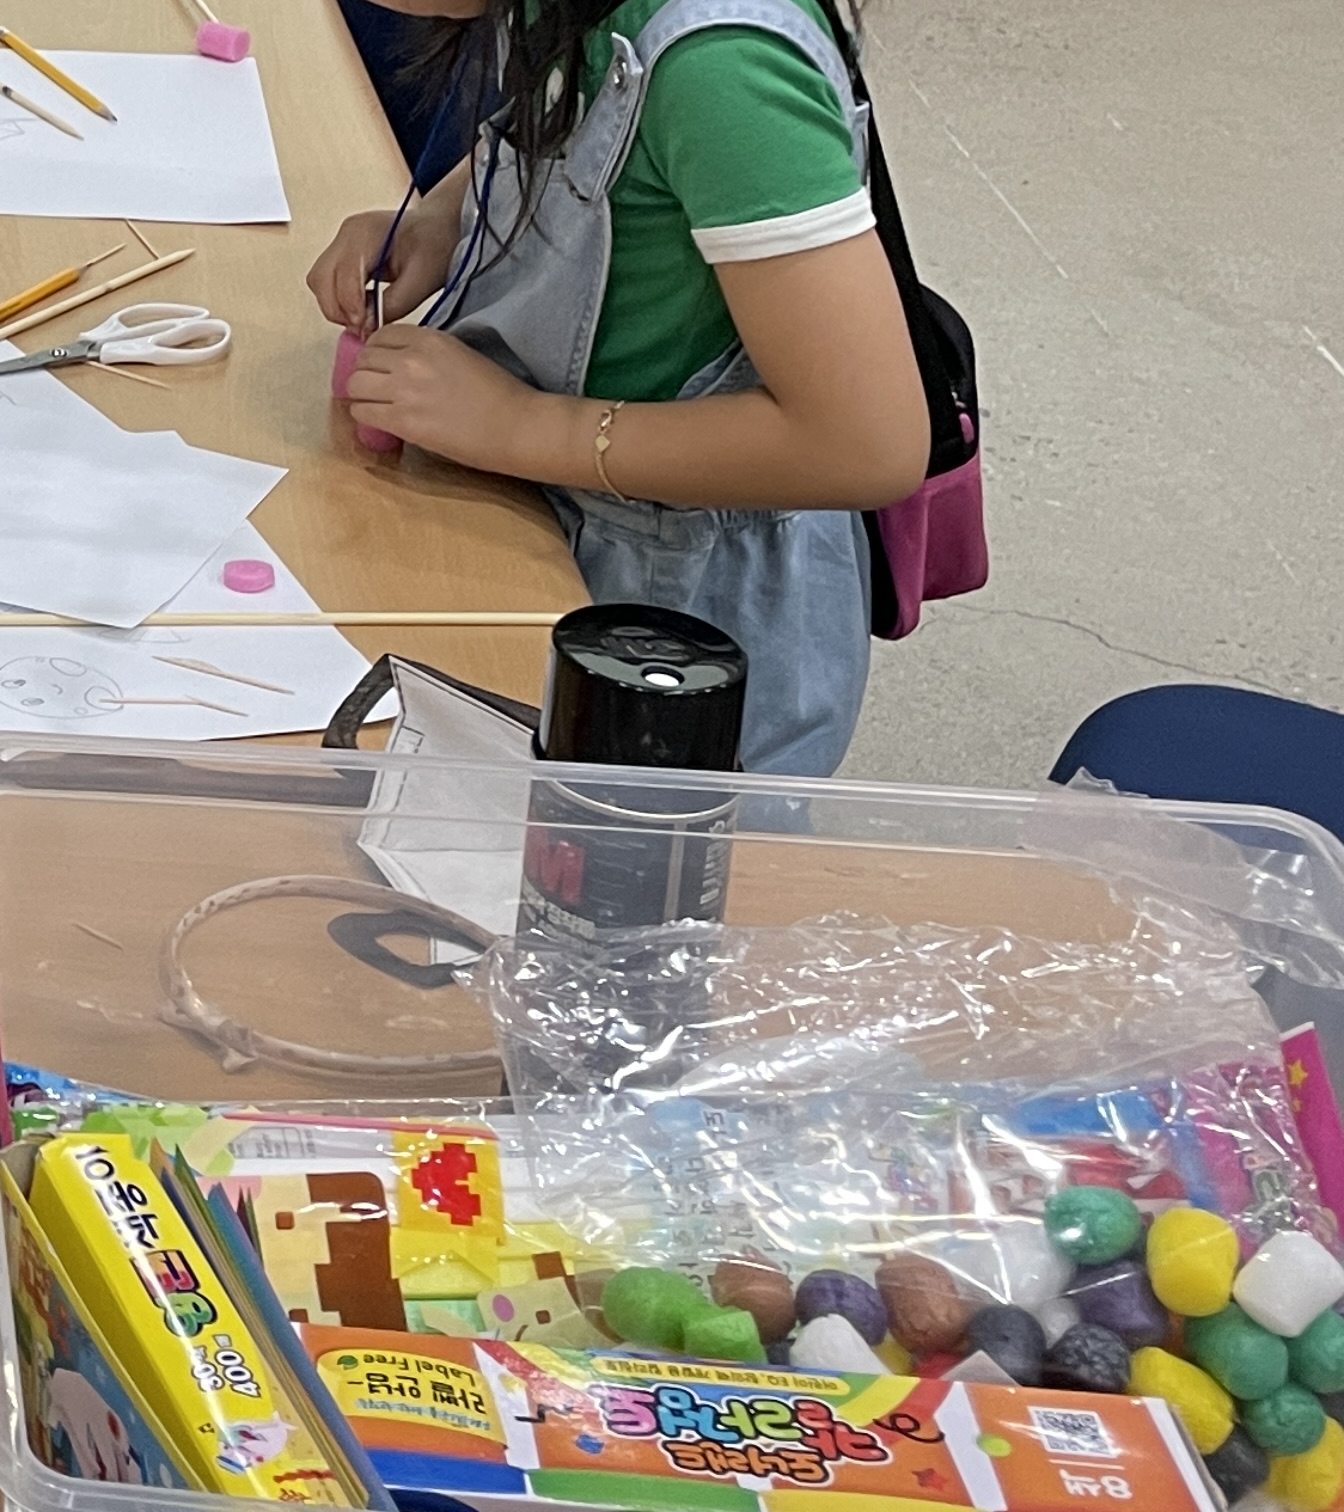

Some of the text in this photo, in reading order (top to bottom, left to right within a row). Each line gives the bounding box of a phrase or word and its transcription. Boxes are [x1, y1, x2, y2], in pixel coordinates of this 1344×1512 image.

[364, 1353, 475, 1386] Label Free
[430, 1380, 487, 1415] 라벨
[664, 1440, 826, 1481] 도너랜드
